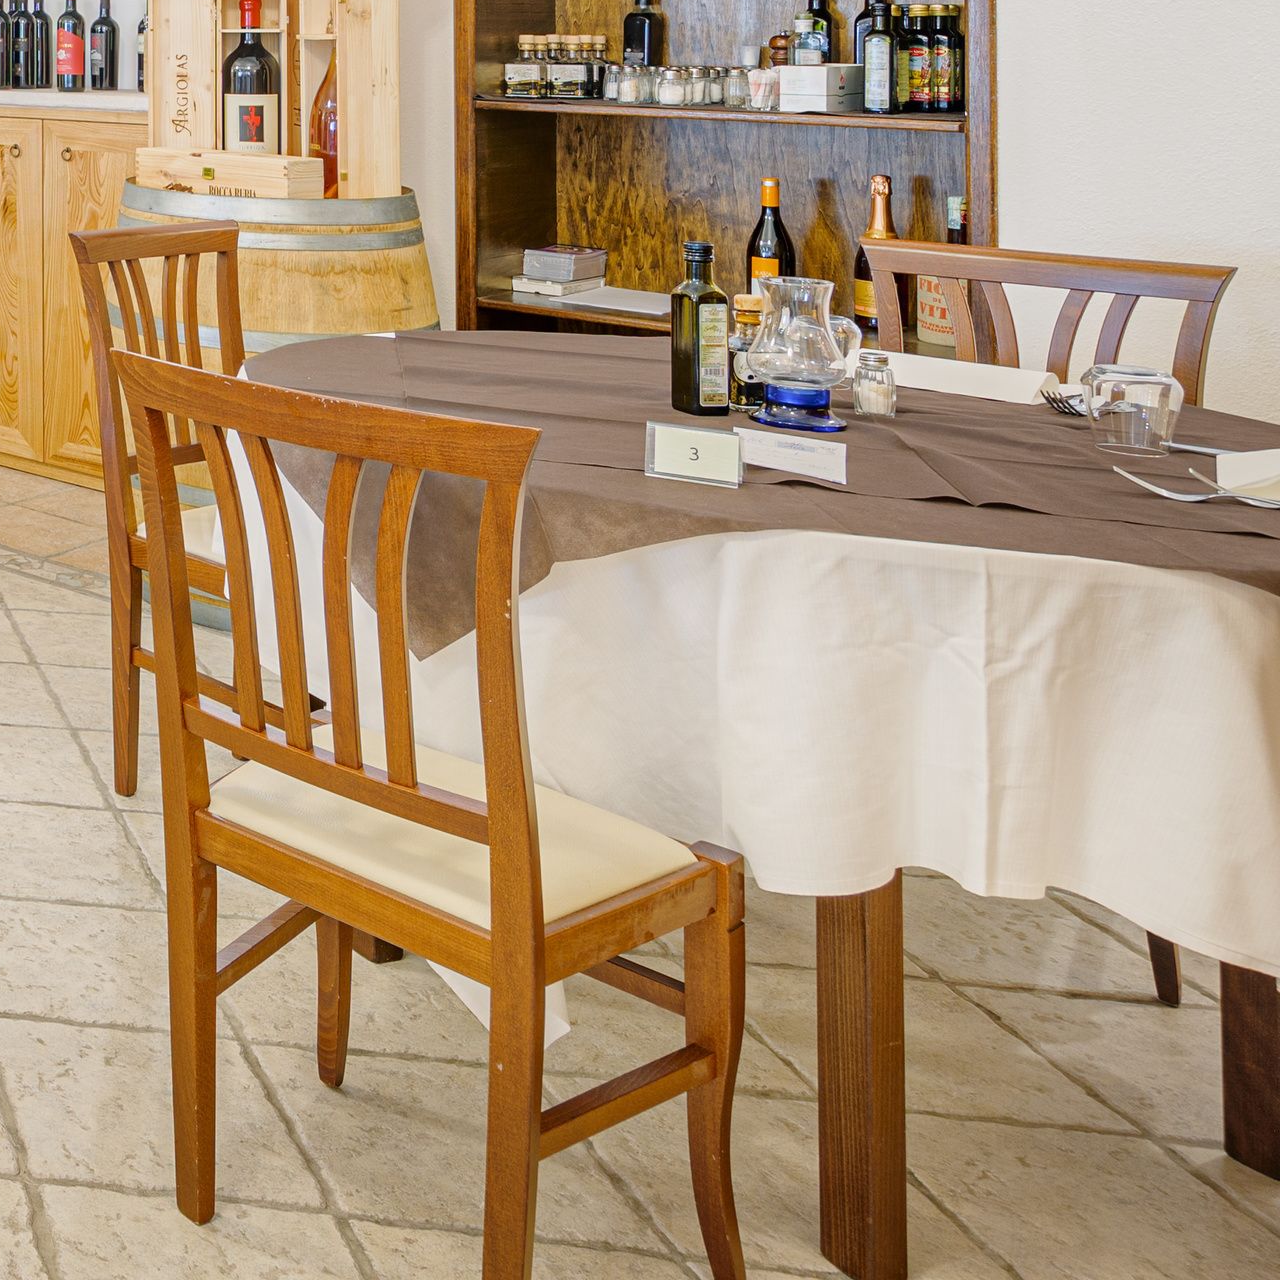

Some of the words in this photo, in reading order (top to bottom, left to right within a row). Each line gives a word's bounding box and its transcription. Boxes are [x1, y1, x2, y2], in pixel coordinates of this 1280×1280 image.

[172, 54, 191, 136] ARGIOLAS
[920, 300, 948, 321] VIT
[689, 447, 700, 461] 3
